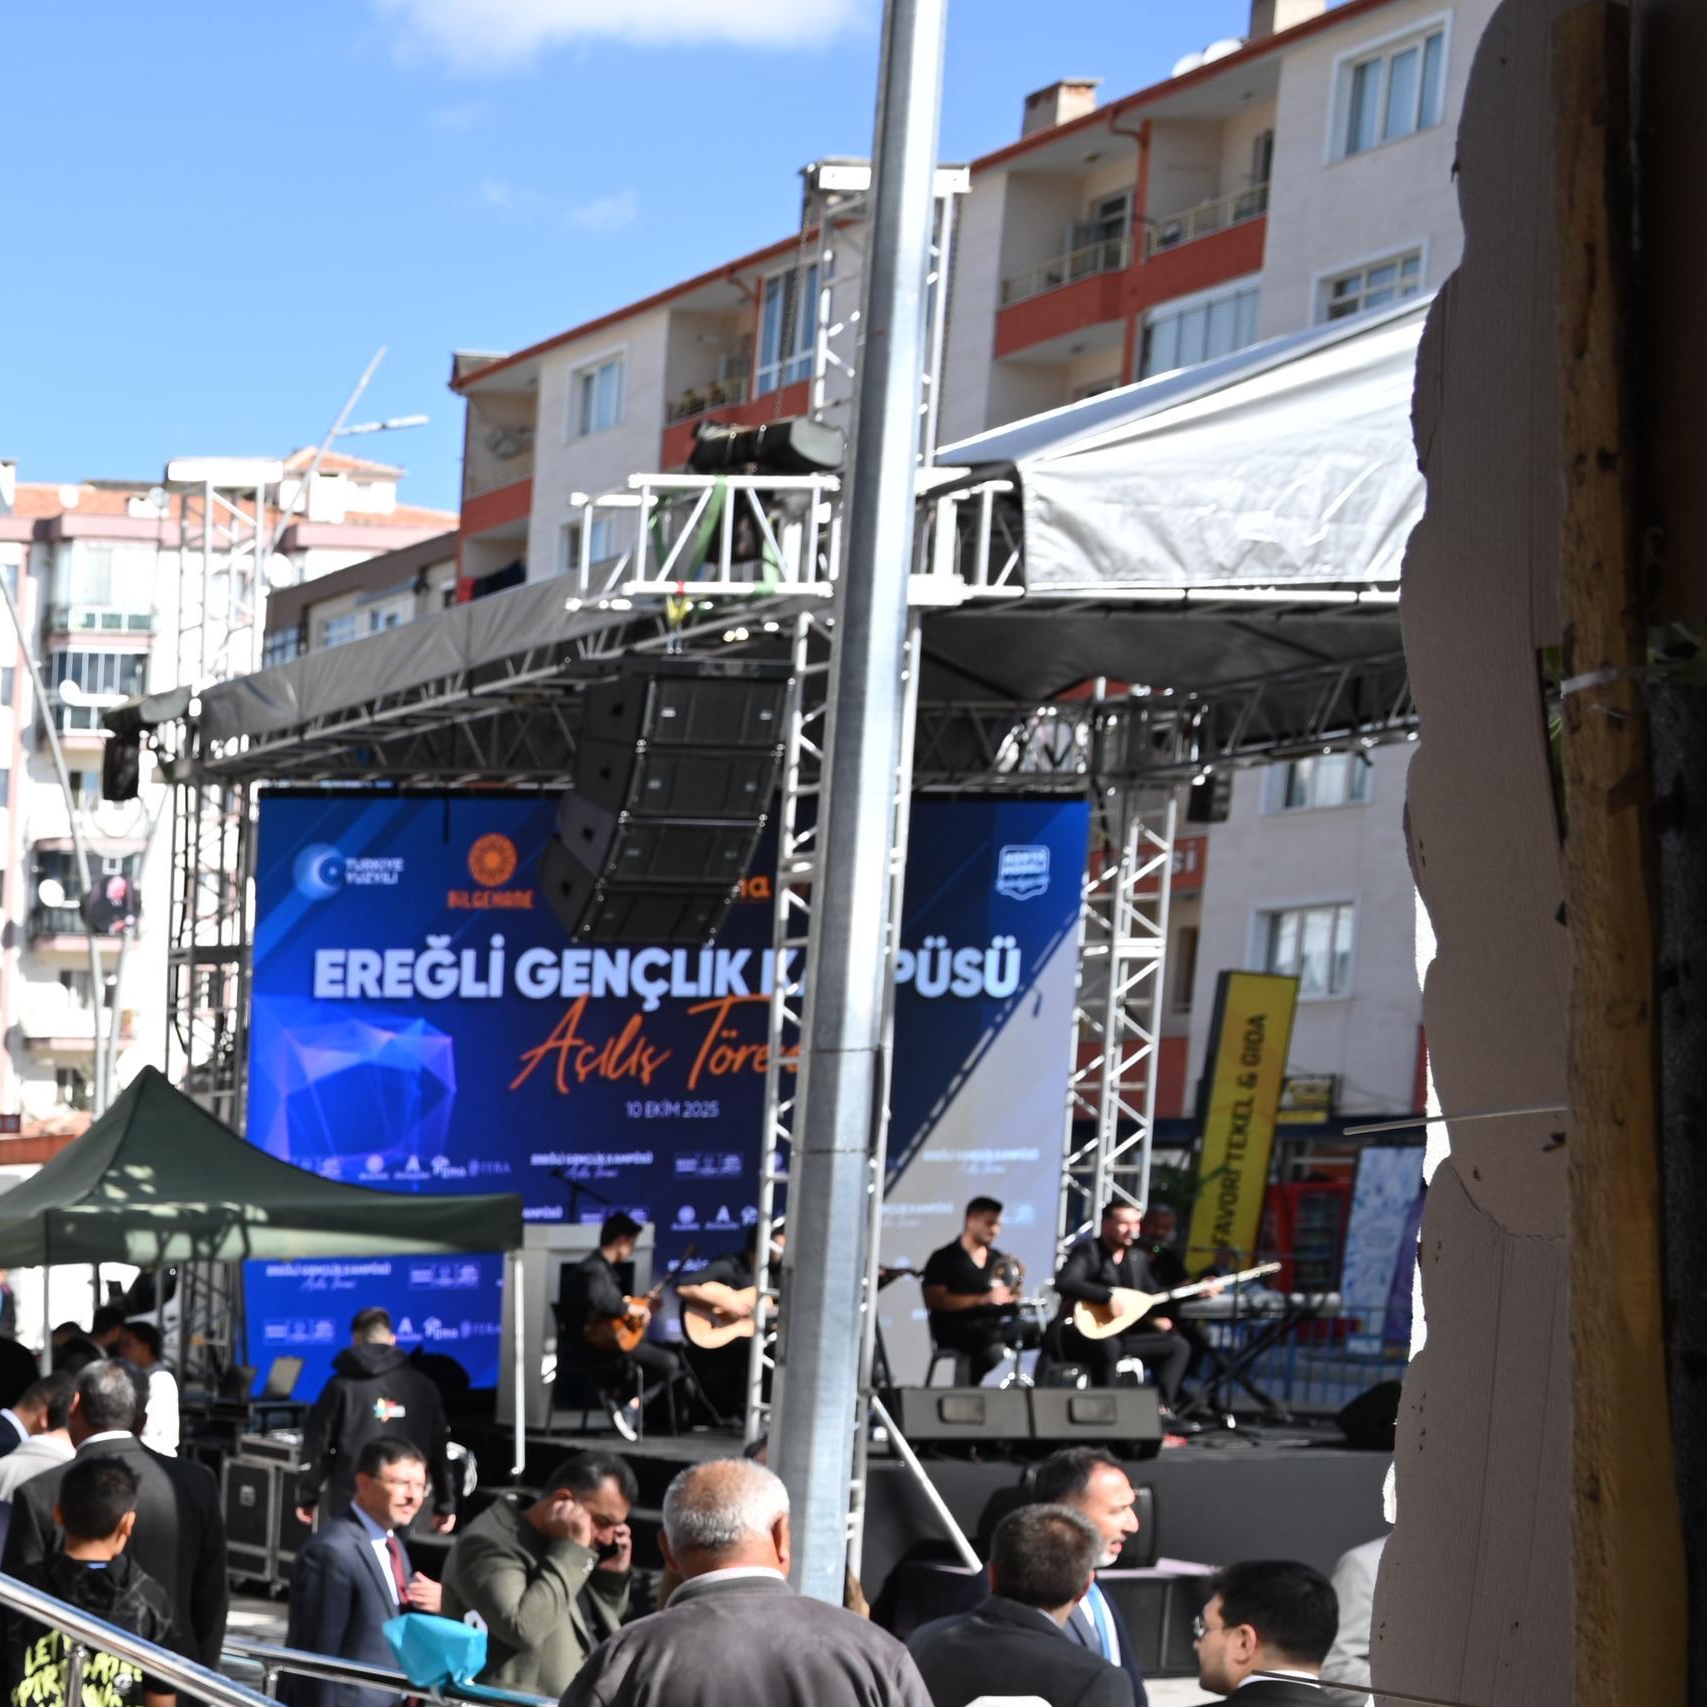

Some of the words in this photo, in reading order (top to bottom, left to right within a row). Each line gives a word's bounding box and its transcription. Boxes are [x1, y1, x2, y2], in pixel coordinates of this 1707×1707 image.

[313, 935, 504, 999] EREĞLİ
[515, 942, 751, 1012] GENÇLİK
[509, 993, 672, 1095] Açılış
[626, 1100, 643, 1118] 10
[683, 1100, 720, 1118] 2025
